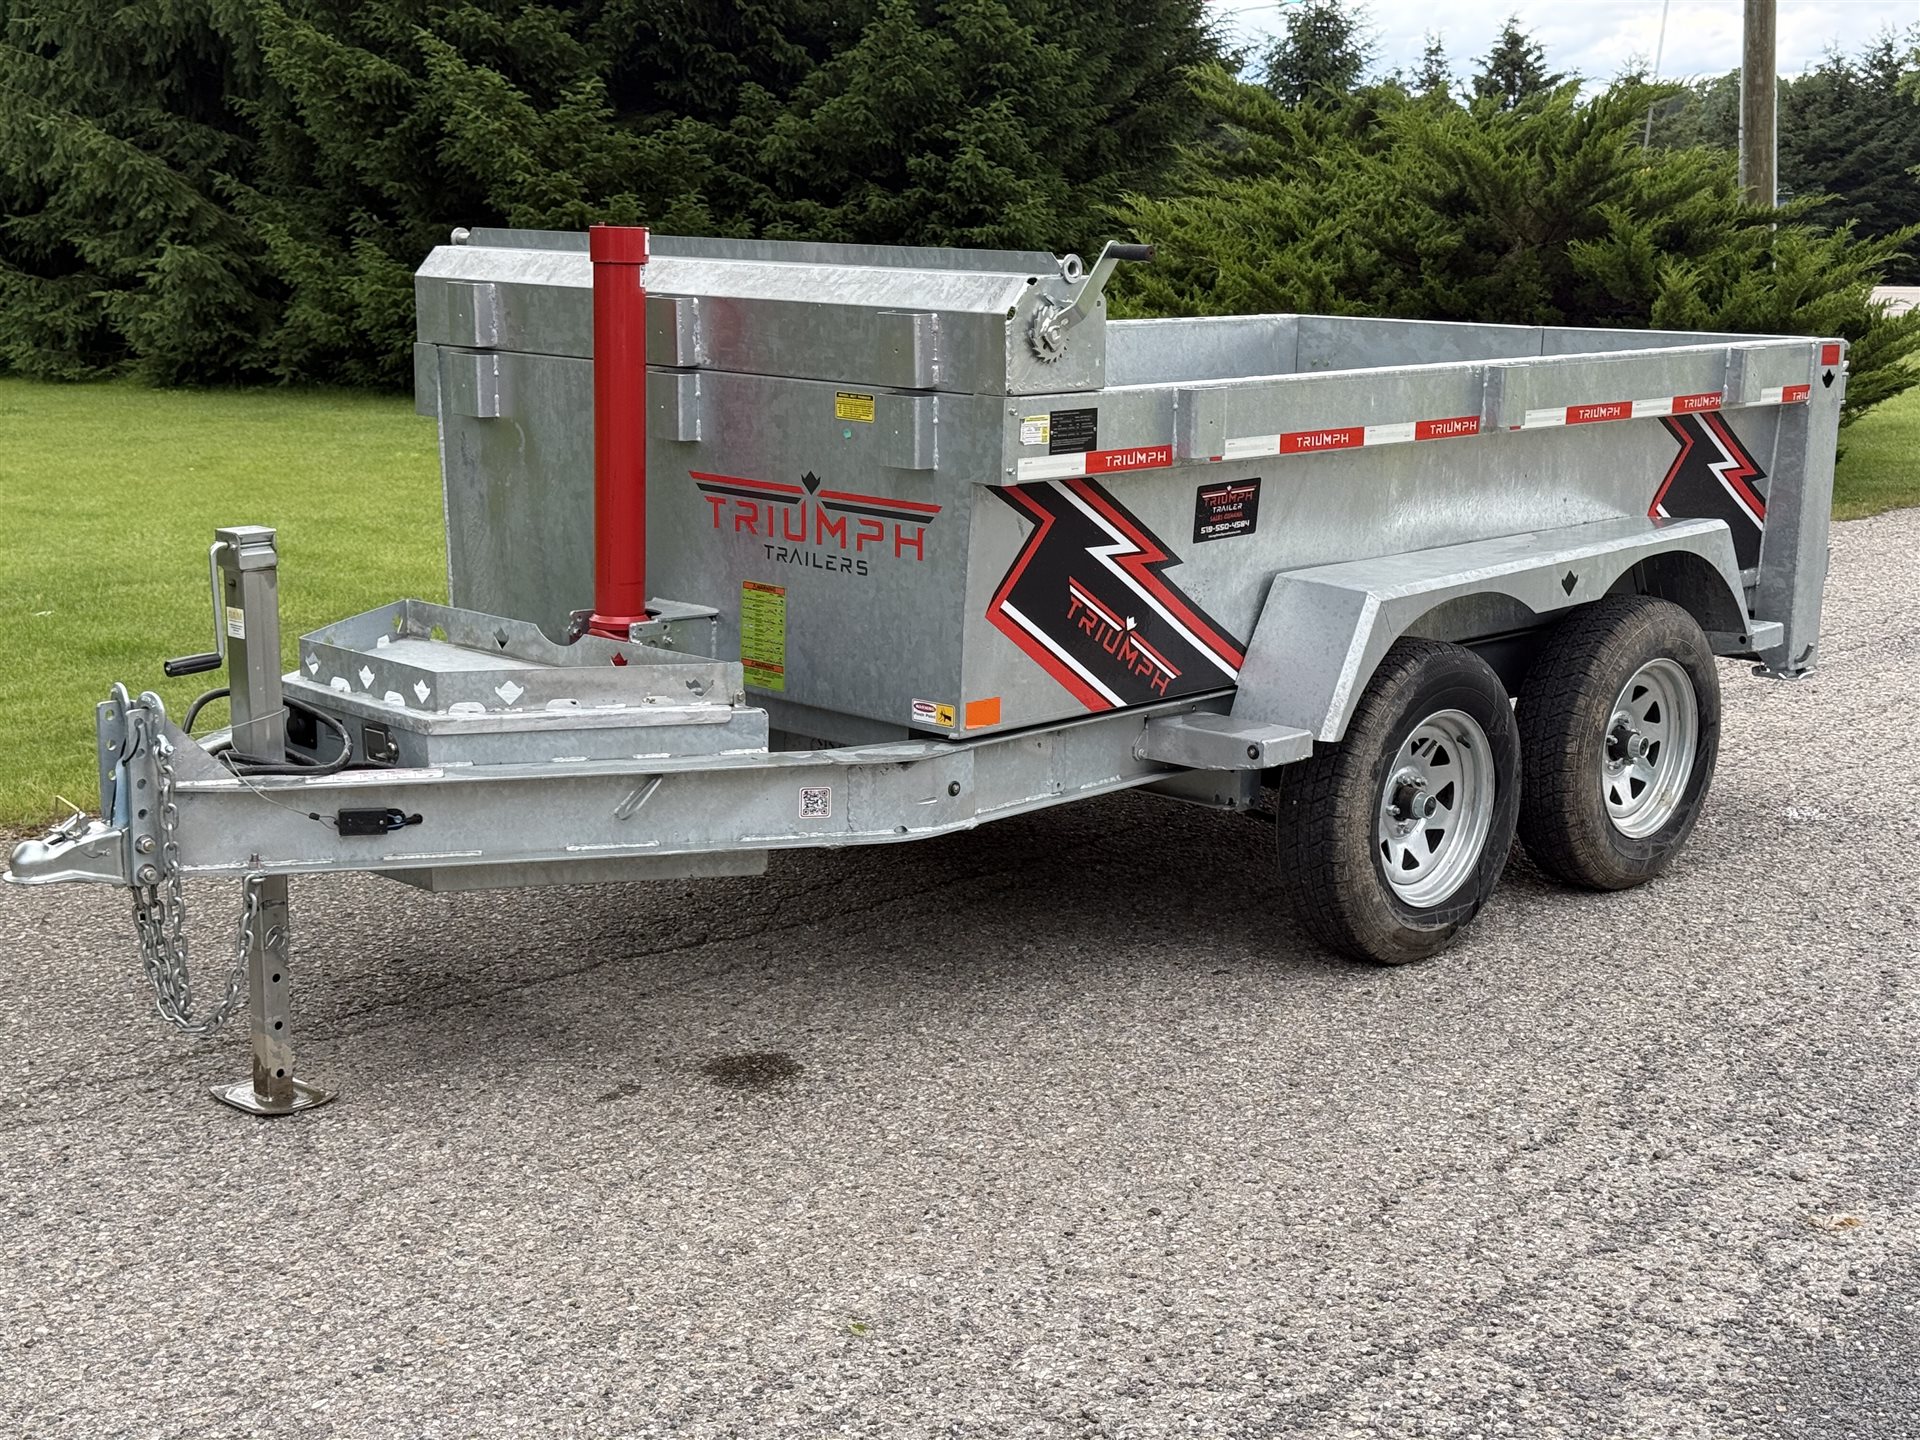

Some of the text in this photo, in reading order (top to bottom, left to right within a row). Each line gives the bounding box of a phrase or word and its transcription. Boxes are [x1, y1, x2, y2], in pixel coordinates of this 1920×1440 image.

[1684, 396, 1722, 409] TRIUMPH
[1579, 406, 1620, 419] TRIUMPH
[1430, 420, 1477, 435] TRIUMPH
[1296, 432, 1349, 448] TRIUMPH
[1105, 450, 1167, 467] TRIUMPH
[1203, 491, 1253, 507] TRIUMPH
[1212, 502, 1243, 514] TRAILER
[704, 496, 926, 562] TRIUMPH
[763, 544, 868, 576] TRAILERS
[1066, 595, 1172, 697] TRIUMPH
